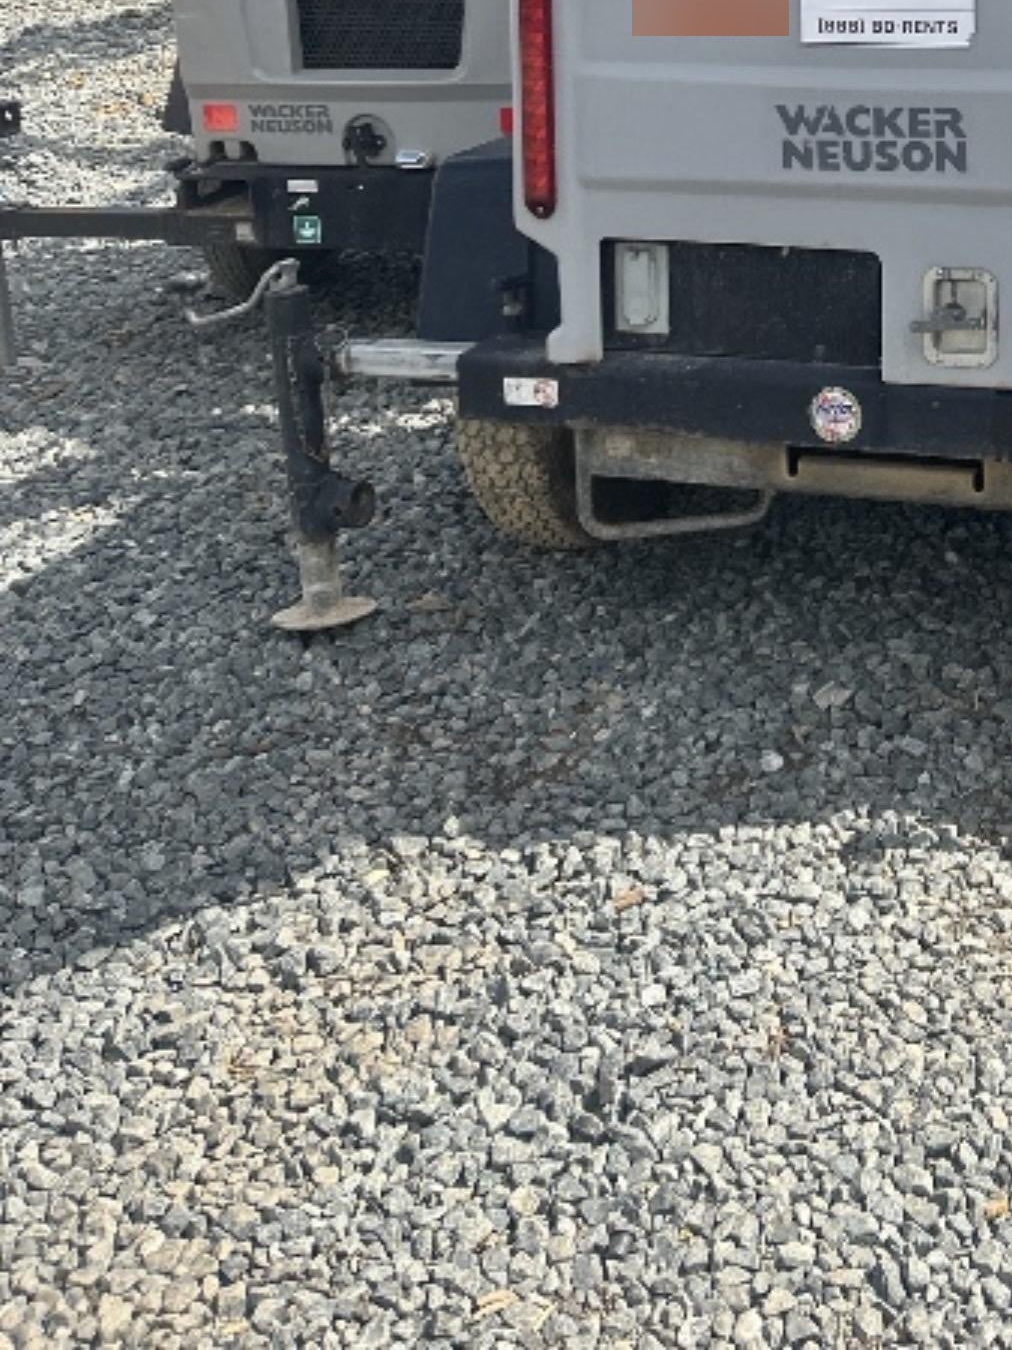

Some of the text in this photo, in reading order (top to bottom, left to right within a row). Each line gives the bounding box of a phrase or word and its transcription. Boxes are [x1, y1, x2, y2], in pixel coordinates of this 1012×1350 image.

[247, 104, 331, 119] WACKER
[775, 105, 967, 140] WACKER
[251, 119, 333, 134] NEUSON
[782, 141, 968, 174] NEUSON
